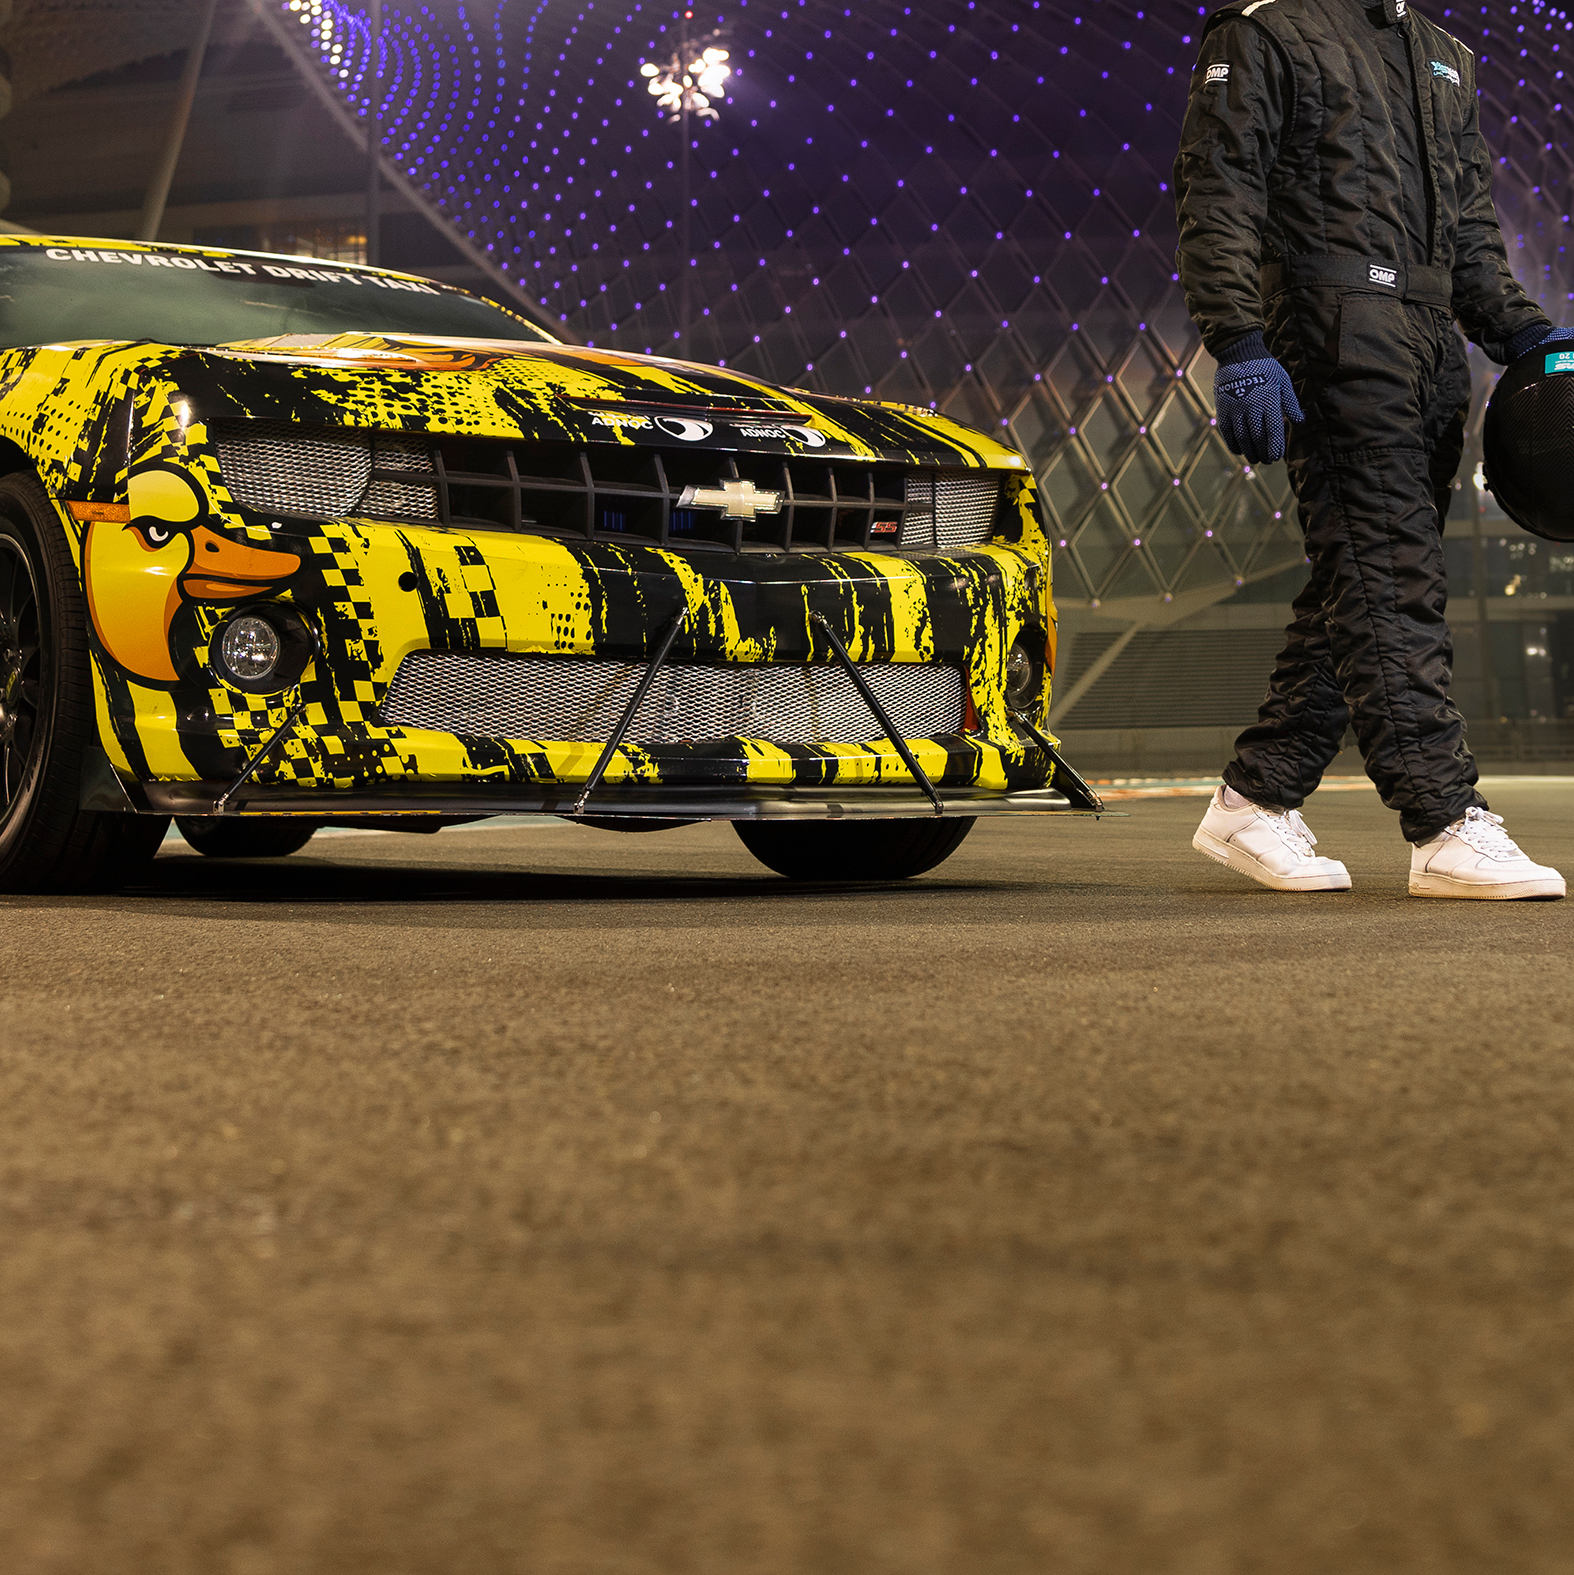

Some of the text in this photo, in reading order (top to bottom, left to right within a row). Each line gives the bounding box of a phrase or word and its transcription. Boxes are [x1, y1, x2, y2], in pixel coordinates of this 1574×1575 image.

[1206, 67, 1229, 80] OMP
[45, 248, 441, 296] CHEVROLET DRIFT TAXI
[1369, 268, 1395, 283] OMP
[1218, 376, 1265, 393] TECHTION
[591, 416, 654, 430] ADNOC
[739, 427, 786, 438] ADNOC
[873, 521, 898, 533] SS
